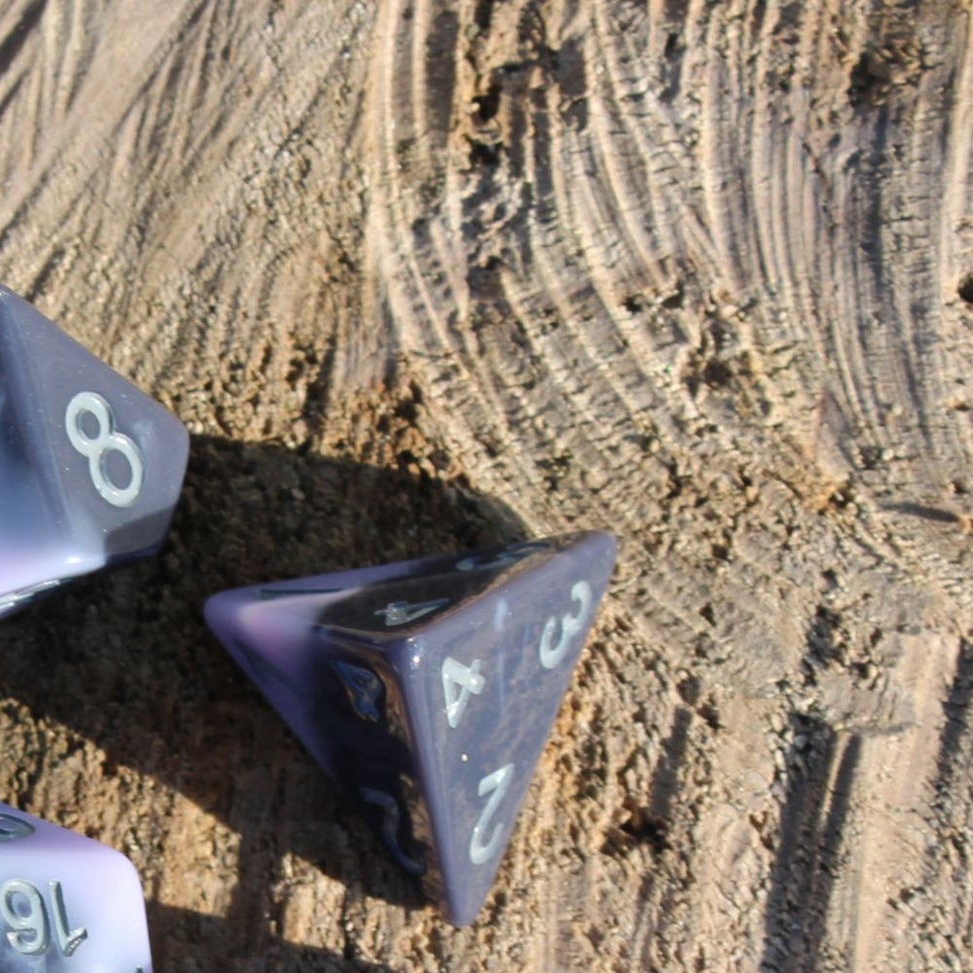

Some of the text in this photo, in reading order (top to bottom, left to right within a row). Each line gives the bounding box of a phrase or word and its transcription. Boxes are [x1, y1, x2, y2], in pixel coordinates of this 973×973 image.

[65, 391, 144, 508] 8
[540, 581, 592, 669] 3
[441, 656, 487, 729] 4
